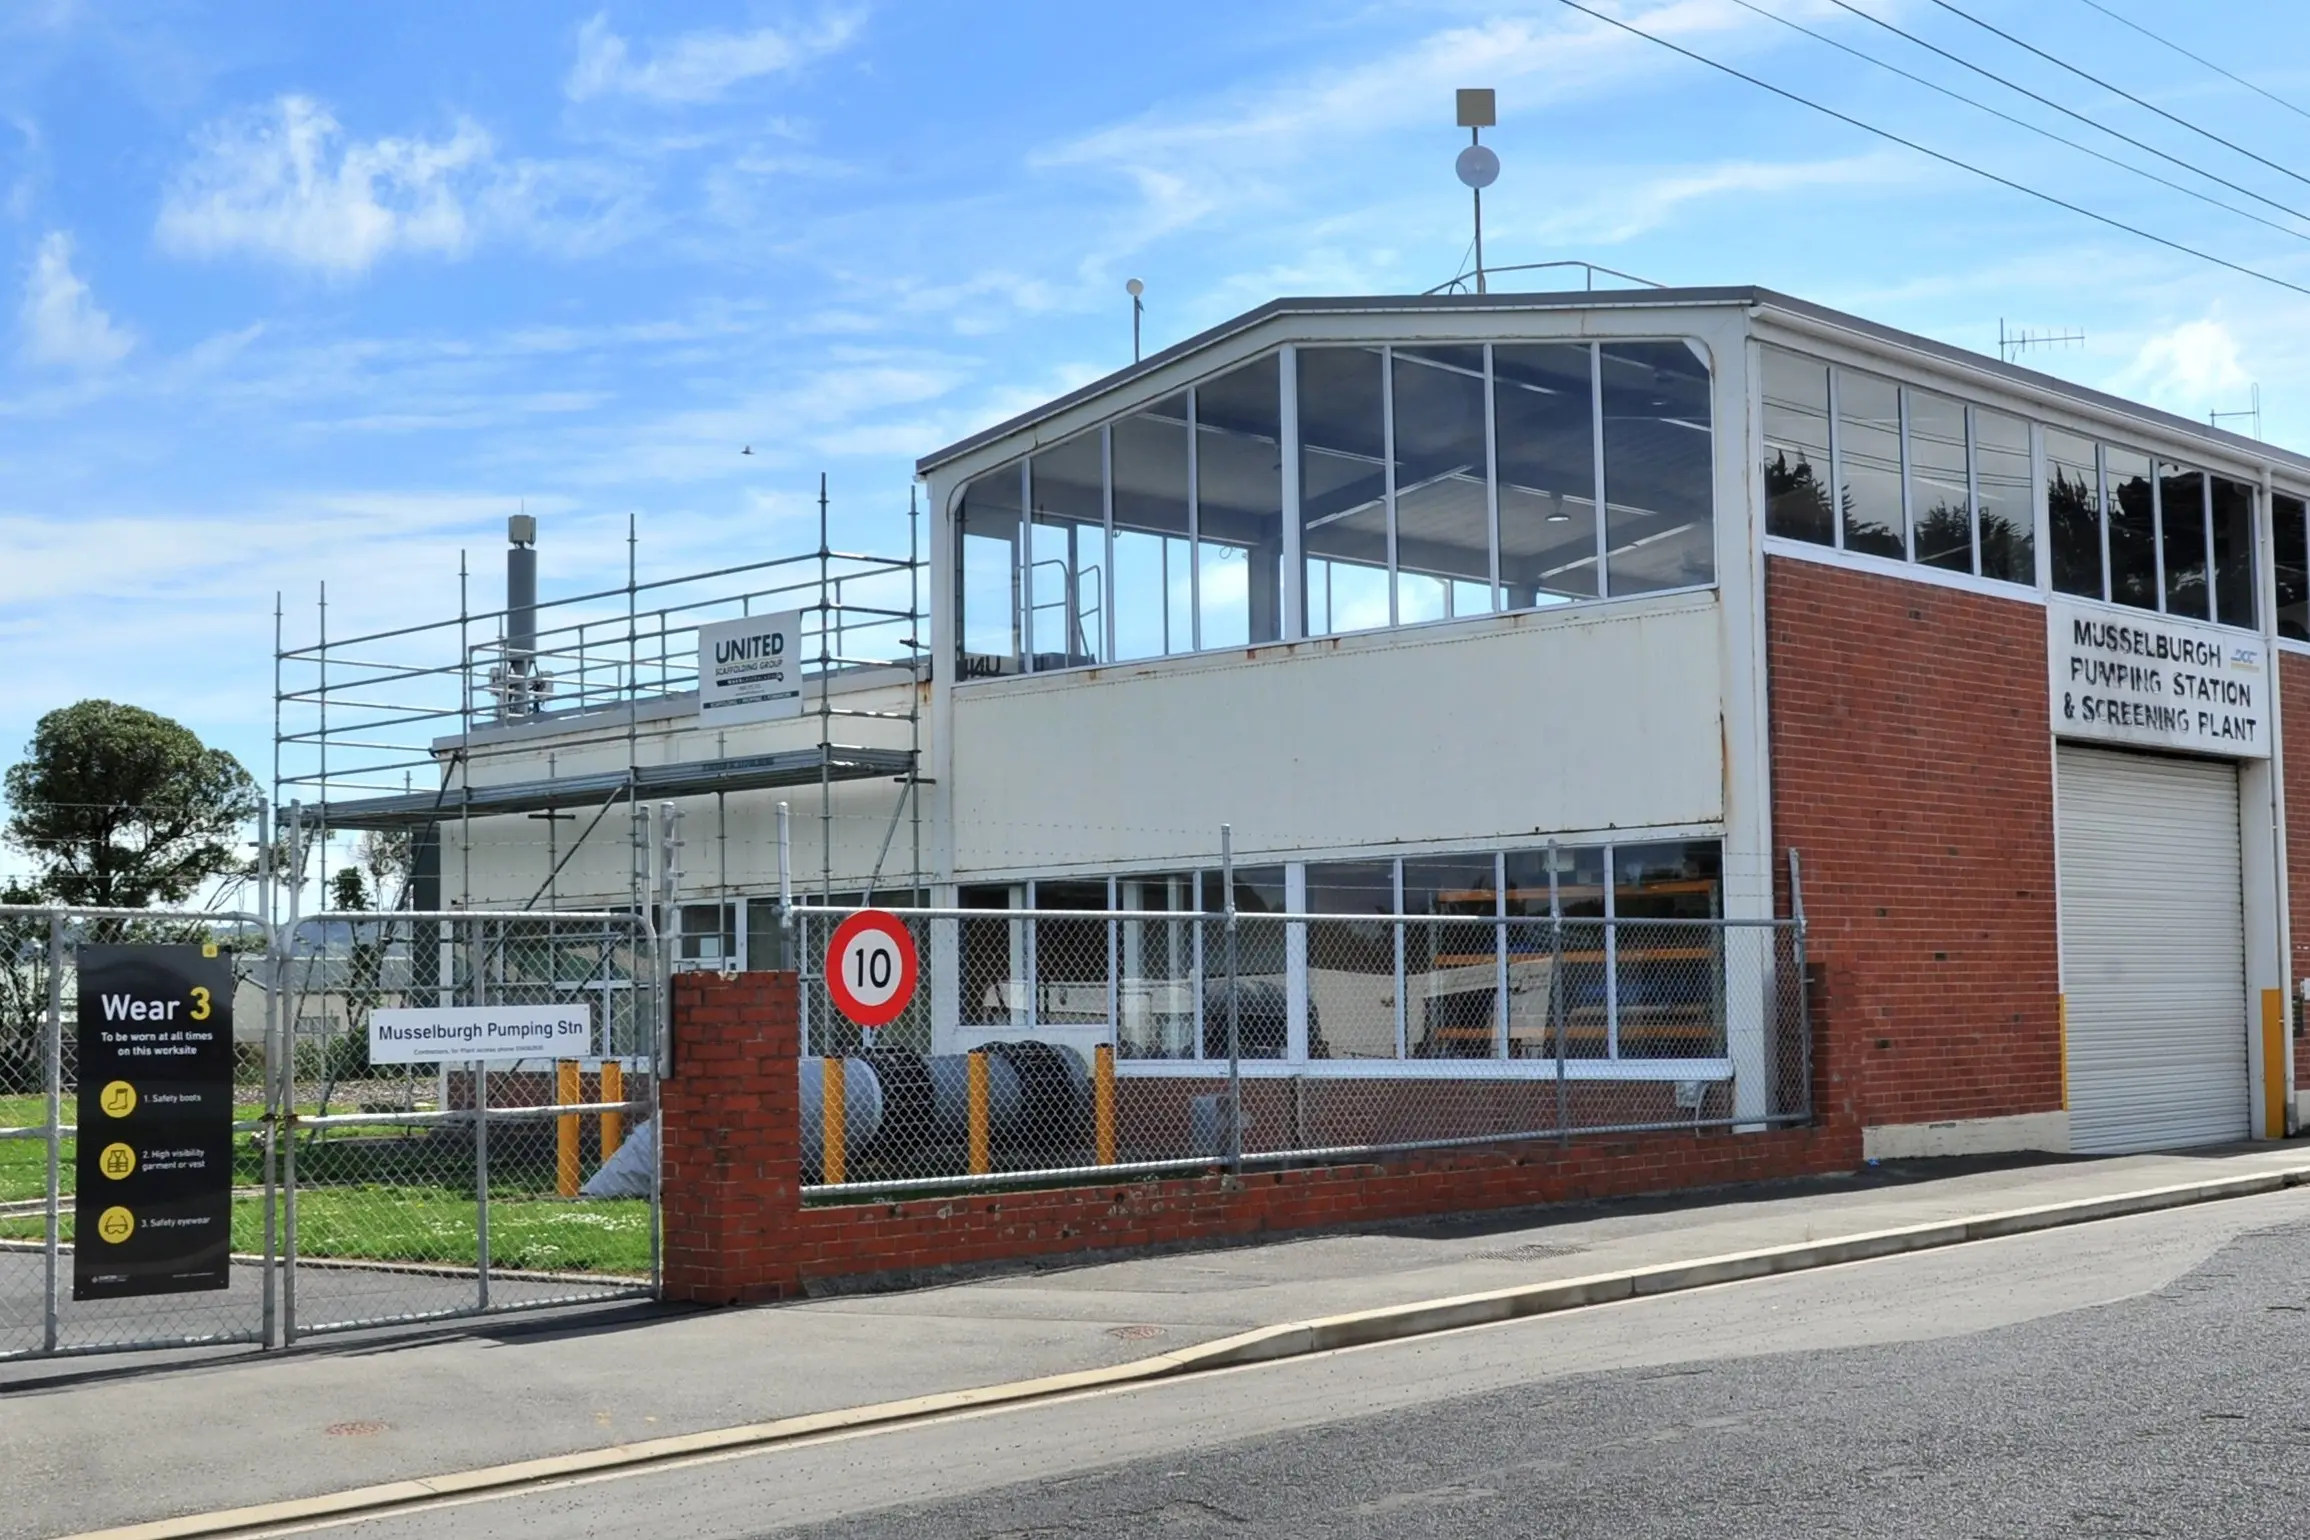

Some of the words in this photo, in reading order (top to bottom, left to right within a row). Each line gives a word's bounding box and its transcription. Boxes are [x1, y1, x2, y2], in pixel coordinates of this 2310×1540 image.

[715, 632, 784, 664] UNITED
[2073, 619, 2221, 668] MUSSELBURGH
[715, 662, 758, 677] SCAFFOLDING
[759, 658, 783, 670] GROUP
[2070, 656, 2161, 694] PUMPING
[2173, 671, 2251, 708] STATION
[2063, 691, 2075, 720] &
[2081, 695, 2189, 734] SCREENING
[2198, 711, 2257, 742] PLANT
[855, 948, 892, 989] 10
[101, 993, 181, 1022] Wear
[189, 985, 212, 1021] 3
[101, 1031, 113, 1042] To
[115, 1031, 128, 1042] be
[130, 1033, 156, 1042] worn
[158, 1031, 169, 1041] at
[170, 1030, 184, 1041] all
[185, 1030, 213, 1041] times
[378, 1022, 483, 1042] Musselburgh
[487, 1021, 553, 1040] Pumping
[557, 1020, 583, 1035] Stn
[117, 1047, 131, 1057] on
[132, 1045, 152, 1056] this
[154, 1045, 198, 1056] worksite
[152, 1093, 178, 1104] Safety
[179, 1093, 203, 1103] boots
[142, 1150, 150, 1159] 2.
[151, 1149, 171, 1160] High
[171, 1148, 205, 1158] visibility
[142, 1160, 177, 1172] garment
[177, 1161, 187, 1169] or
[188, 1159, 206, 1169] vest
[141, 1218, 149, 1229] 3.
[150, 1217, 176, 1228] Safety
[177, 1216, 212, 1228] eyewear
